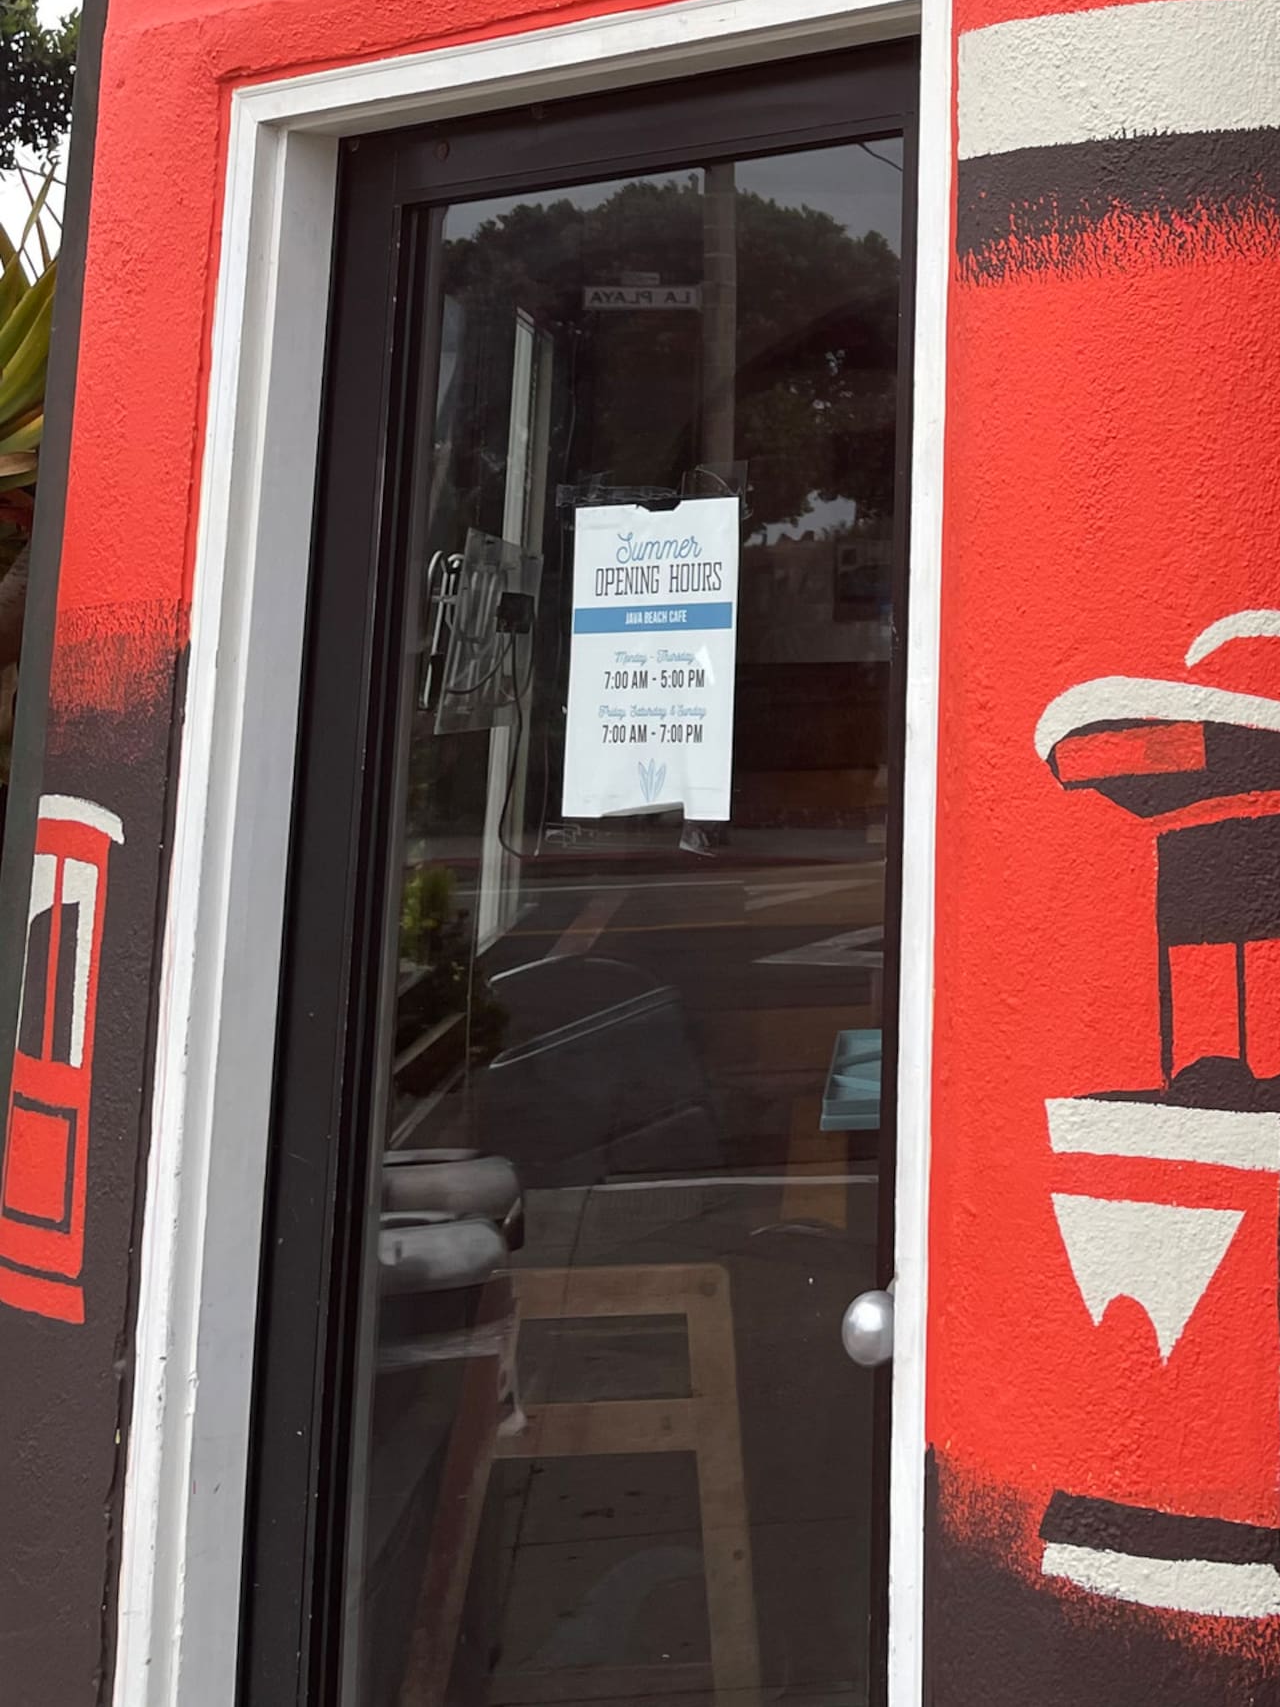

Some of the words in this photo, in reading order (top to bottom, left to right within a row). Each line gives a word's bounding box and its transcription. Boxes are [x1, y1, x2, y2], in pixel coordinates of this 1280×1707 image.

[616, 532, 702, 564] Summer
[595, 565, 660, 596] OPENING
[669, 562, 722, 593] HOURS
[625, 612, 643, 624] JAVA
[644, 610, 668, 624] BEACH
[669, 610, 688, 623] CAFE
[604, 670, 629, 689] 7:00
[631, 670, 649, 689] AM
[660, 669, 685, 688] 5:00
[688, 669, 705, 688] PM
[602, 724, 627, 744] 7:00
[628, 724, 648, 743] AM
[659, 723, 684, 743] 7:00
[685, 723, 704, 743] PM
